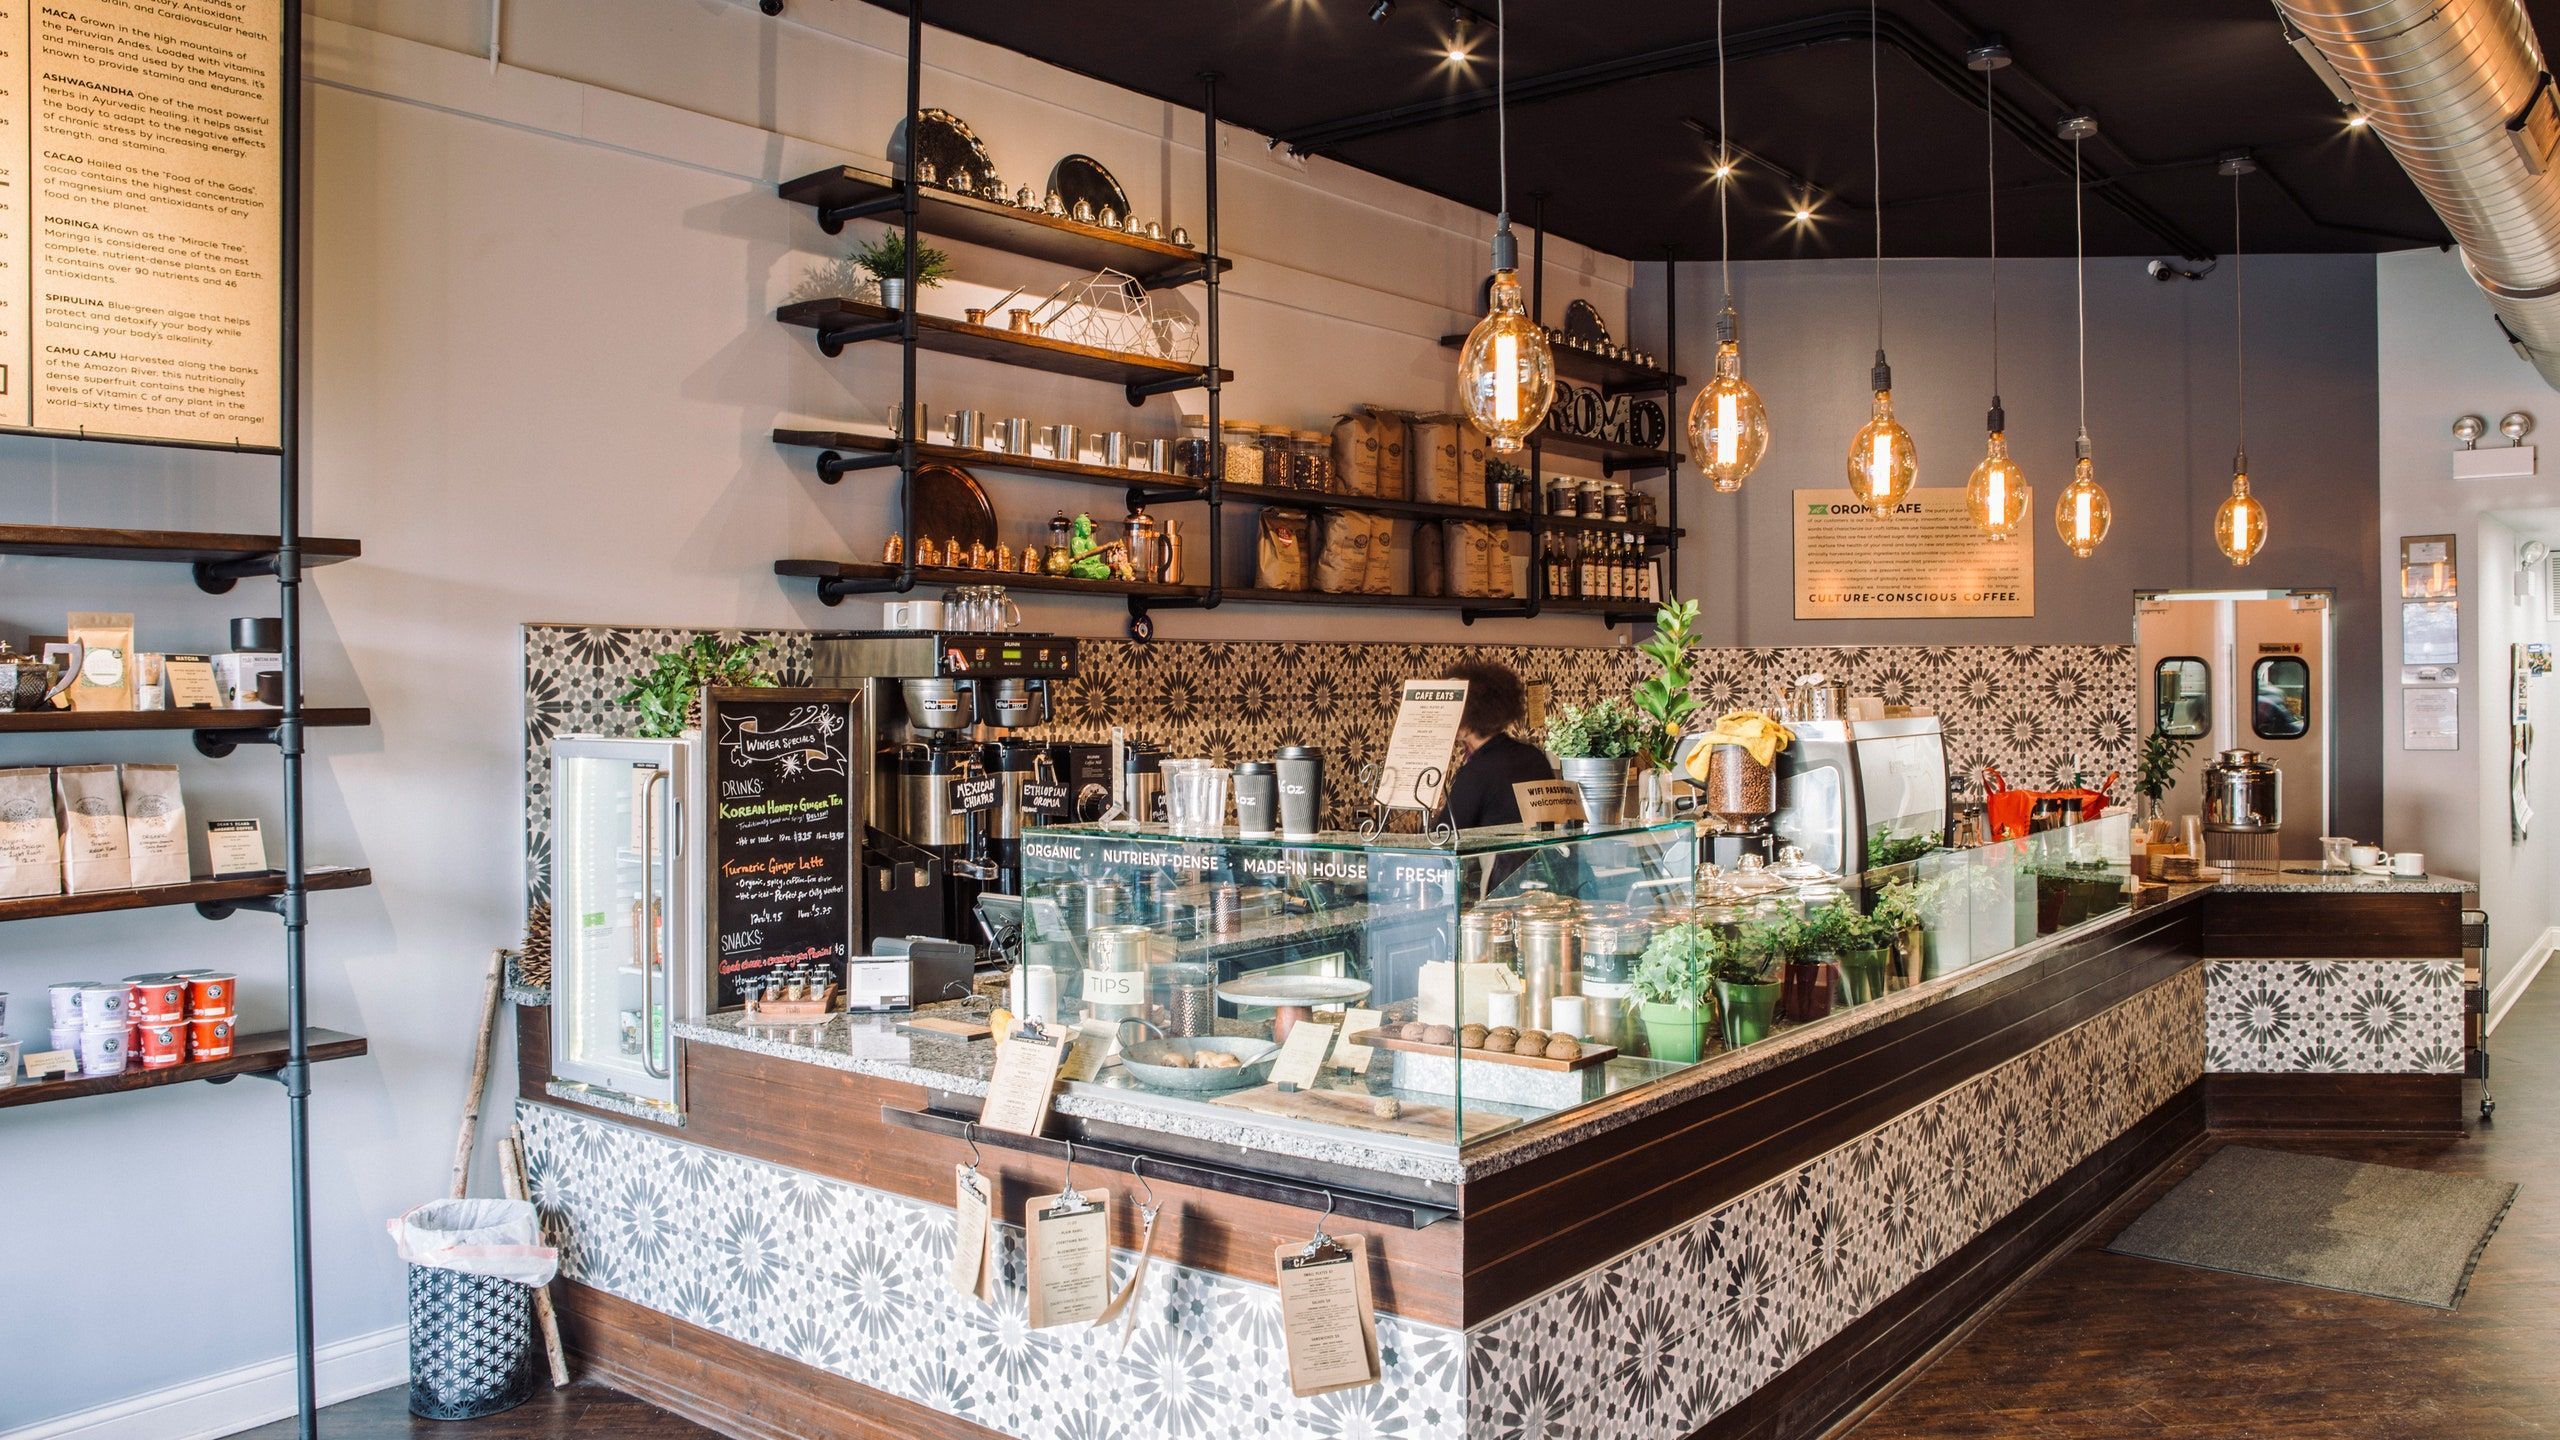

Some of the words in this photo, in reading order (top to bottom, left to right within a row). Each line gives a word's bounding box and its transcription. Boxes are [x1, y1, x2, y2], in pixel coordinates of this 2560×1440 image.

[134, 4, 154, 14] and
[157, 8, 234, 33] Cardiovascular
[41, 6, 77, 21] MACA
[80, 16, 116, 30] Grown
[118, 24, 129, 34] in
[132, 28, 151, 39] the
[153, 32, 177, 45] high
[179, 40, 234, 57] mountains
[236, 53, 247, 61] of
[42, 20, 64, 31] the
[65, 25, 114, 43] Peruvian
[154, 46, 195, 61] Loaded
[197, 56, 222, 67] with
[221, 61, 266, 77] vitamins
[42, 34, 64, 44] and
[67, 40, 115, 56] minerals
[117, 50, 139, 61] and
[141, 56, 168, 67] used
[170, 61, 186, 72] by
[185, 65, 206, 76] the
[42, 46, 80, 60] known
[83, 54, 96, 64] to
[96, 59, 139, 74] provide
[142, 69, 185, 84] stamina
[186, 79, 208, 88] and
[42, 73, 137, 98] ASHWAGANDHA
[136, 92, 160, 103] One
[162, 97, 173, 106] of
[176, 100, 195, 110] the
[197, 106, 224, 116] most
[226, 112, 269, 125] powerful
[43, 150, 84, 164] CACAO
[87, 159, 122, 171] Hailed
[125, 166, 138, 174] as
[141, 168, 160, 178] the
[194, 178, 205, 186] of
[207, 180, 225, 190] the
[44, 216, 100, 230] MORINGA
[103, 225, 139, 236] Known
[158, 233, 176, 242] the
[45, 294, 104, 307] SPIRULINA
[108, 301, 165, 314] Blue-green
[168, 310, 196, 319] algae
[199, 313, 221, 322] that
[224, 316, 251, 326] helps
[45, 345, 80, 355] CAMU
[83, 349, 117, 359] CAMU
[120, 354, 175, 366] Harvested
[178, 361, 206, 371] along
[209, 363, 226, 372] the
[229, 365, 259, 375] banks
[113, 403, 143, 413] times
[146, 406, 171, 415] than
[174, 409, 196, 417] that
[228, 415, 265, 424] orange!
[1831, 504, 1873, 514] OROM
[1893, 503, 1922, 514] AFE
[1808, 593, 1957, 603] CULTURE-CONSCIOUS
[1963, 592, 2020, 602] COFFEE.
[1414, 691, 1434, 701] CAFE
[1435, 691, 1455, 701] EATS
[746, 739, 781, 752] WINTER
[782, 735, 816, 748] SPECIALS
[722, 778, 765, 797] DRINKS:
[957, 778, 995, 798] MEXICAN
[1023, 784, 1067, 798] ETHIOPIAN
[1527, 787, 1544, 796] WIFI
[720, 802, 766, 819] KOREAN
[963, 792, 994, 808] CHIAPAS
[1033, 796, 1061, 808] OROMIA
[721, 858, 766, 878] Turmeric
[768, 857, 796, 875] Ginger
[799, 855, 824, 870] Latte
[1026, 843, 1082, 860] ORGANIC
[1103, 849, 1219, 870] NUTRIENT-DENSE
[1244, 858, 1307, 876] MADE-IN
[1313, 863, 1367, 879] HOUSE
[1395, 866, 1449, 884] FRESH
[721, 929, 764, 952] SNACKS:
[834, 943, 845, 956] $8
[1091, 975, 1131, 995] TIPS
